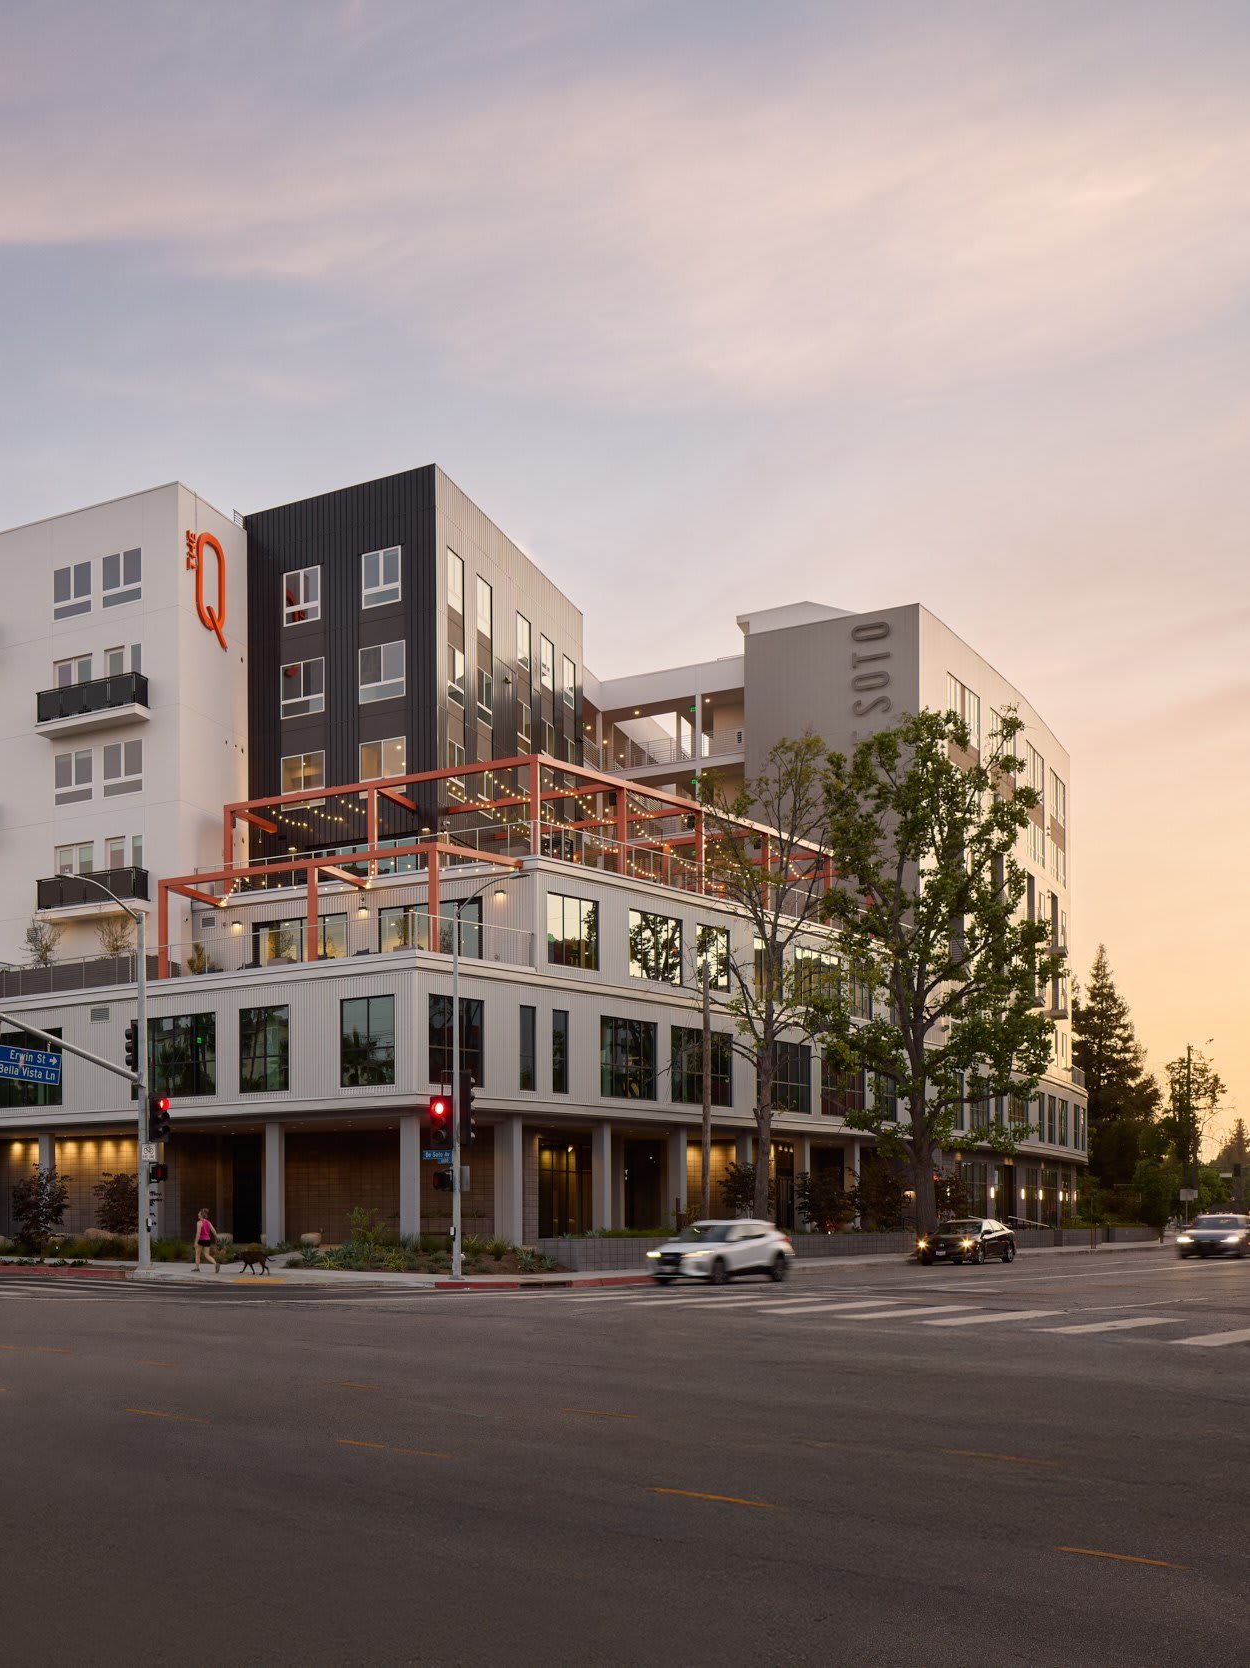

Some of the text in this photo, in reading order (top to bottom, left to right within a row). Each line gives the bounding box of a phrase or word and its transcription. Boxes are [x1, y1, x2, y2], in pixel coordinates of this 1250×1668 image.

[186, 530, 227, 651] THE Q
[851, 621, 892, 716] SOTO
[10, 1049, 46, 1064] Erwin St
[22, 1066, 42, 1079] Vista
[45, 1070, 56, 1080] Ln
